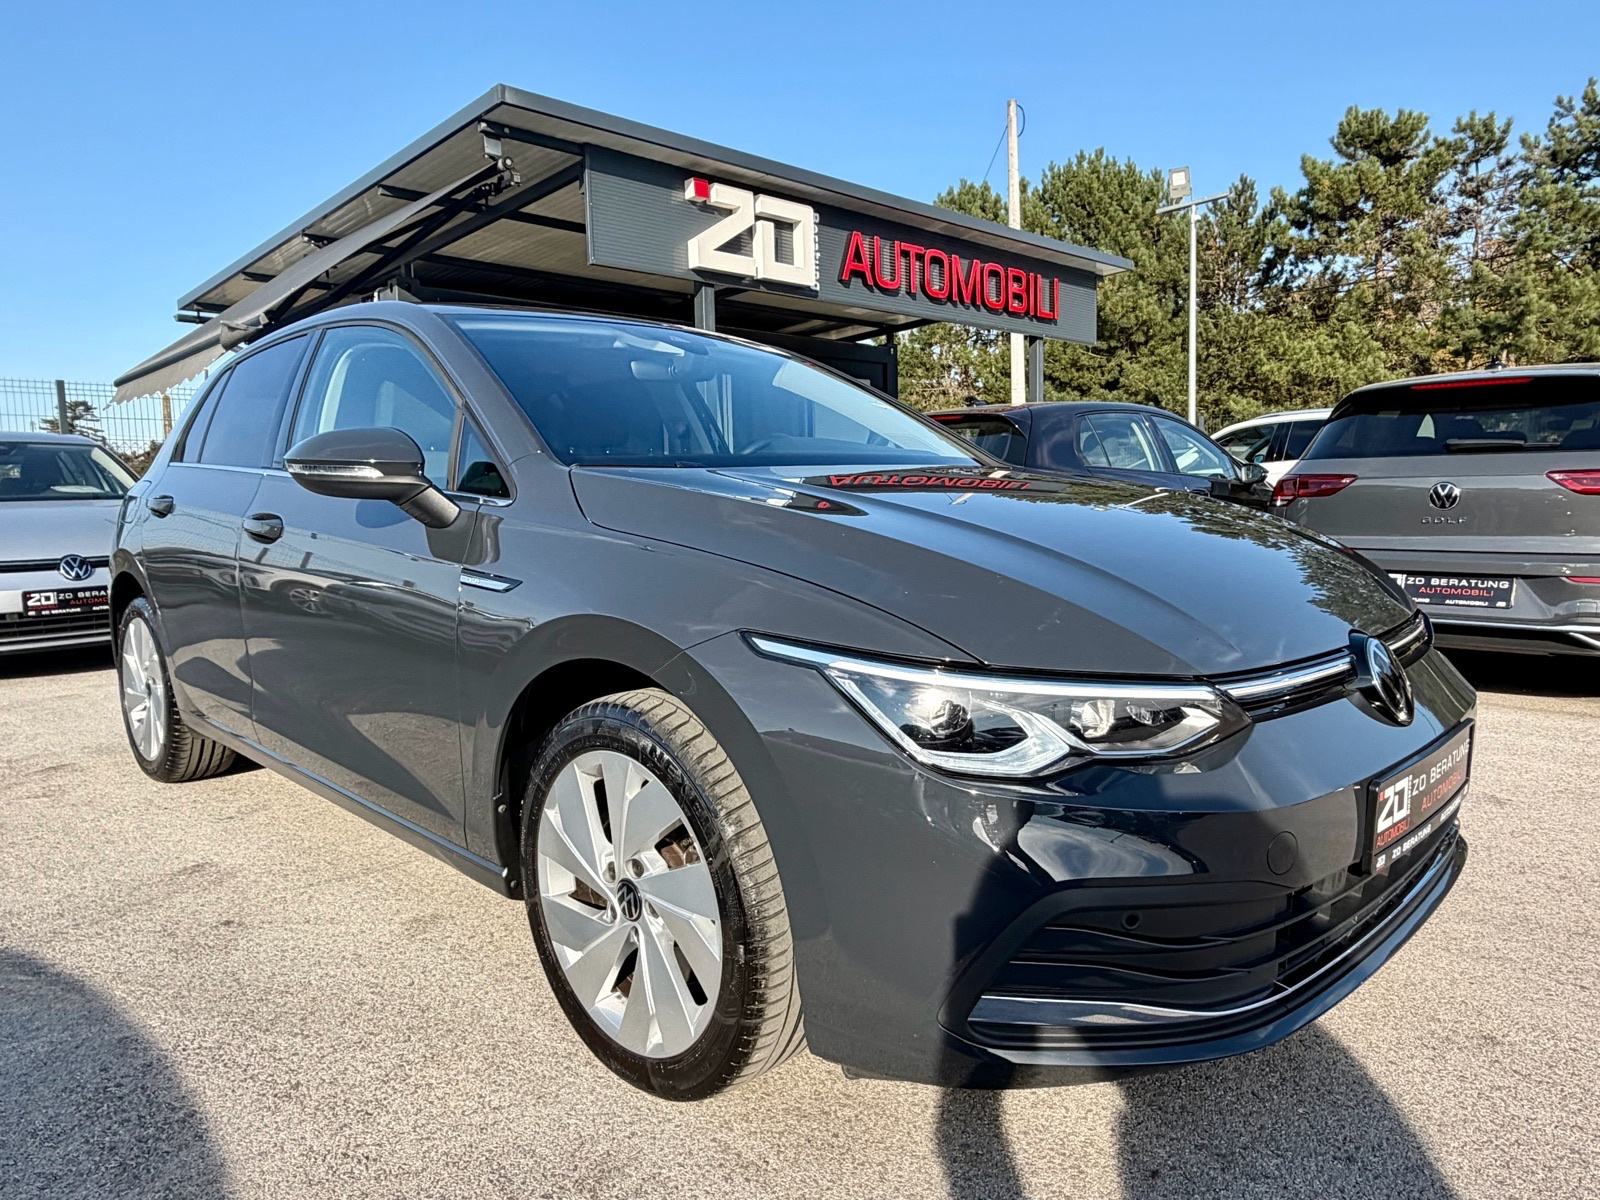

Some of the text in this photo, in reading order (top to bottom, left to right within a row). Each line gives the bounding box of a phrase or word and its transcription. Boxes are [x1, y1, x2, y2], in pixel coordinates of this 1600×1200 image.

[839, 231, 1059, 321] AUTOMOBILI
[1407, 577, 1425, 585] ZD
[1430, 577, 1510, 589] BERATUNG
[58, 592, 73, 600] ZD
[1419, 586, 1494, 597] AUTOMOBILI
[1412, 774, 1426, 797] ZD
[1430, 738, 1470, 784] BERATUNG
